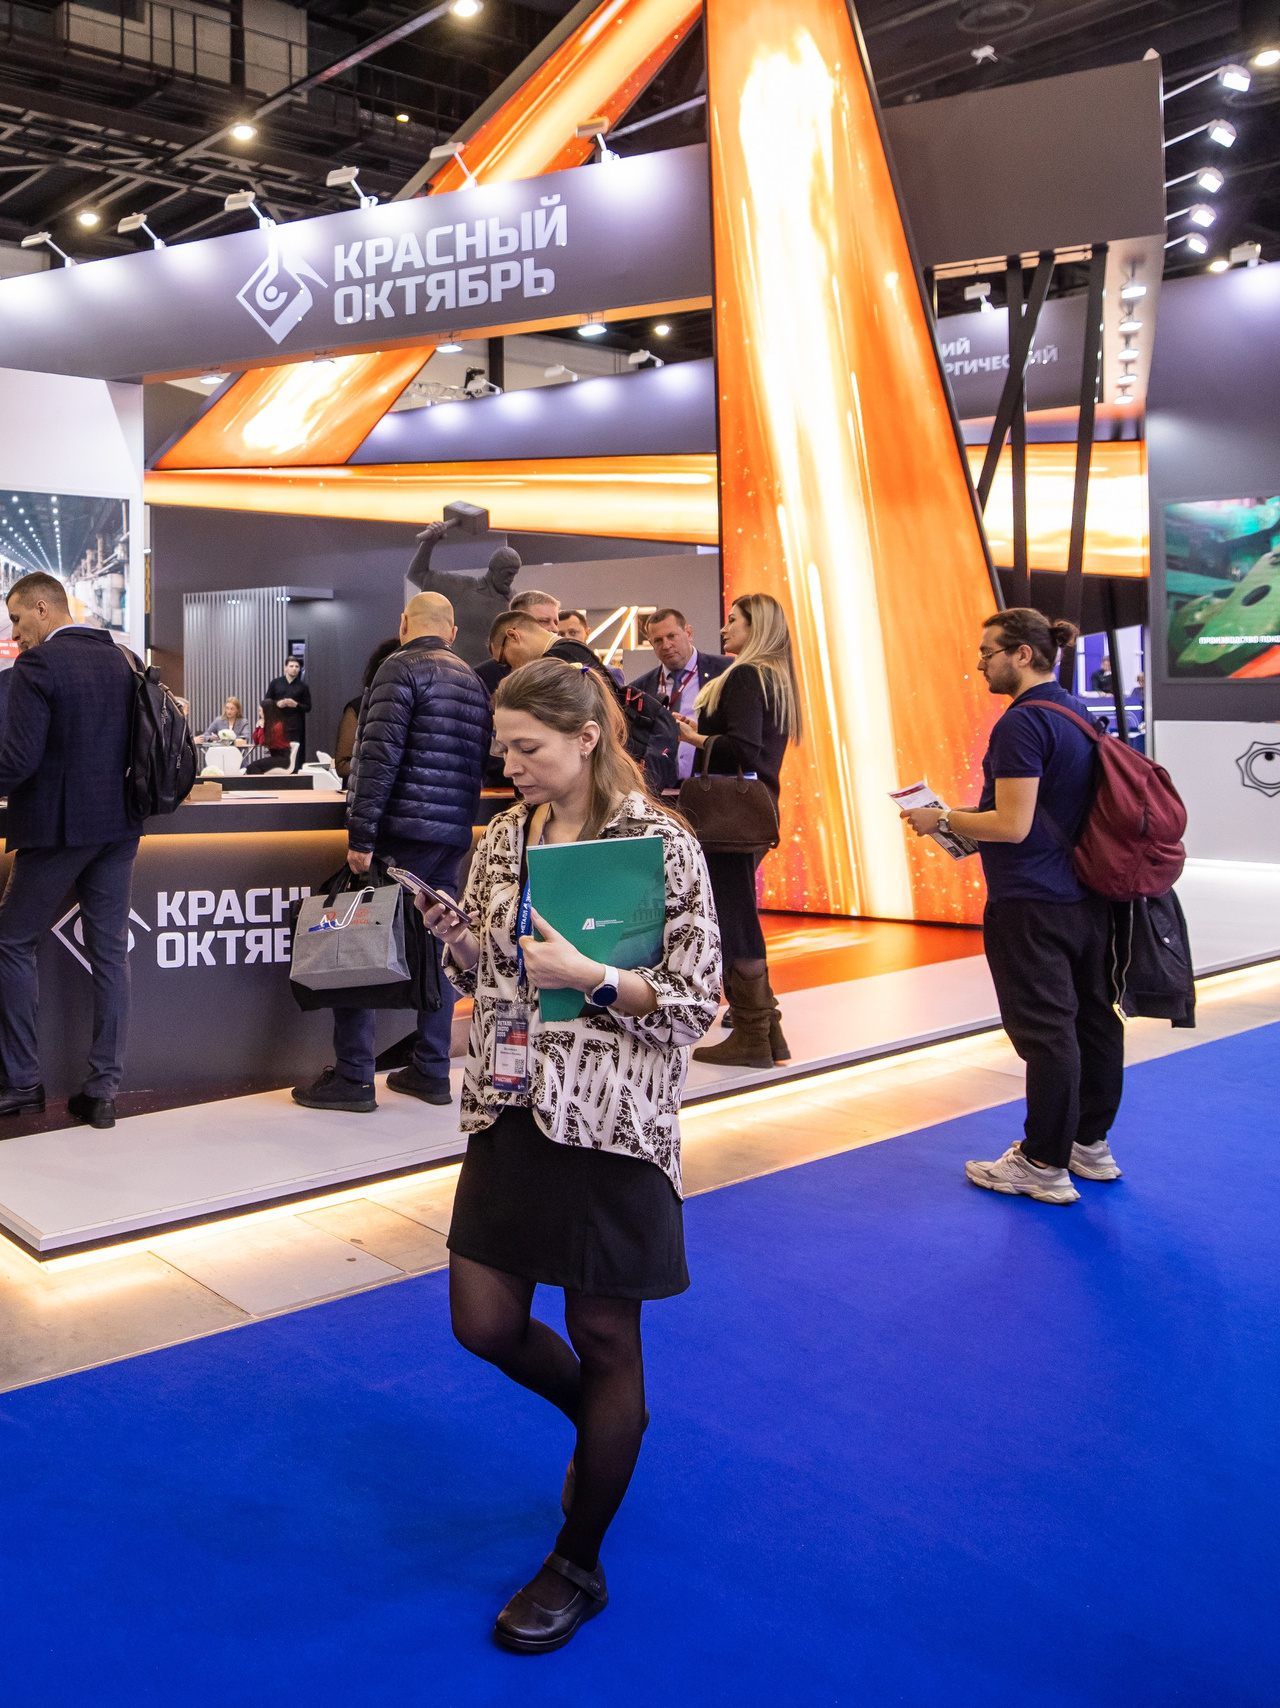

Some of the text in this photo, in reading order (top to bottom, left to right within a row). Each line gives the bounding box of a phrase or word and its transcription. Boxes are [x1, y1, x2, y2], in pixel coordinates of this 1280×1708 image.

[334, 193, 568, 282] КРАСНЫЙ
[333, 257, 556, 325] ОКТЯБРЬ
[940, 337, 971, 358] ИЙ
[156, 886, 311, 928] КРАСН
[156, 927, 291, 969] ОКТЯБ
